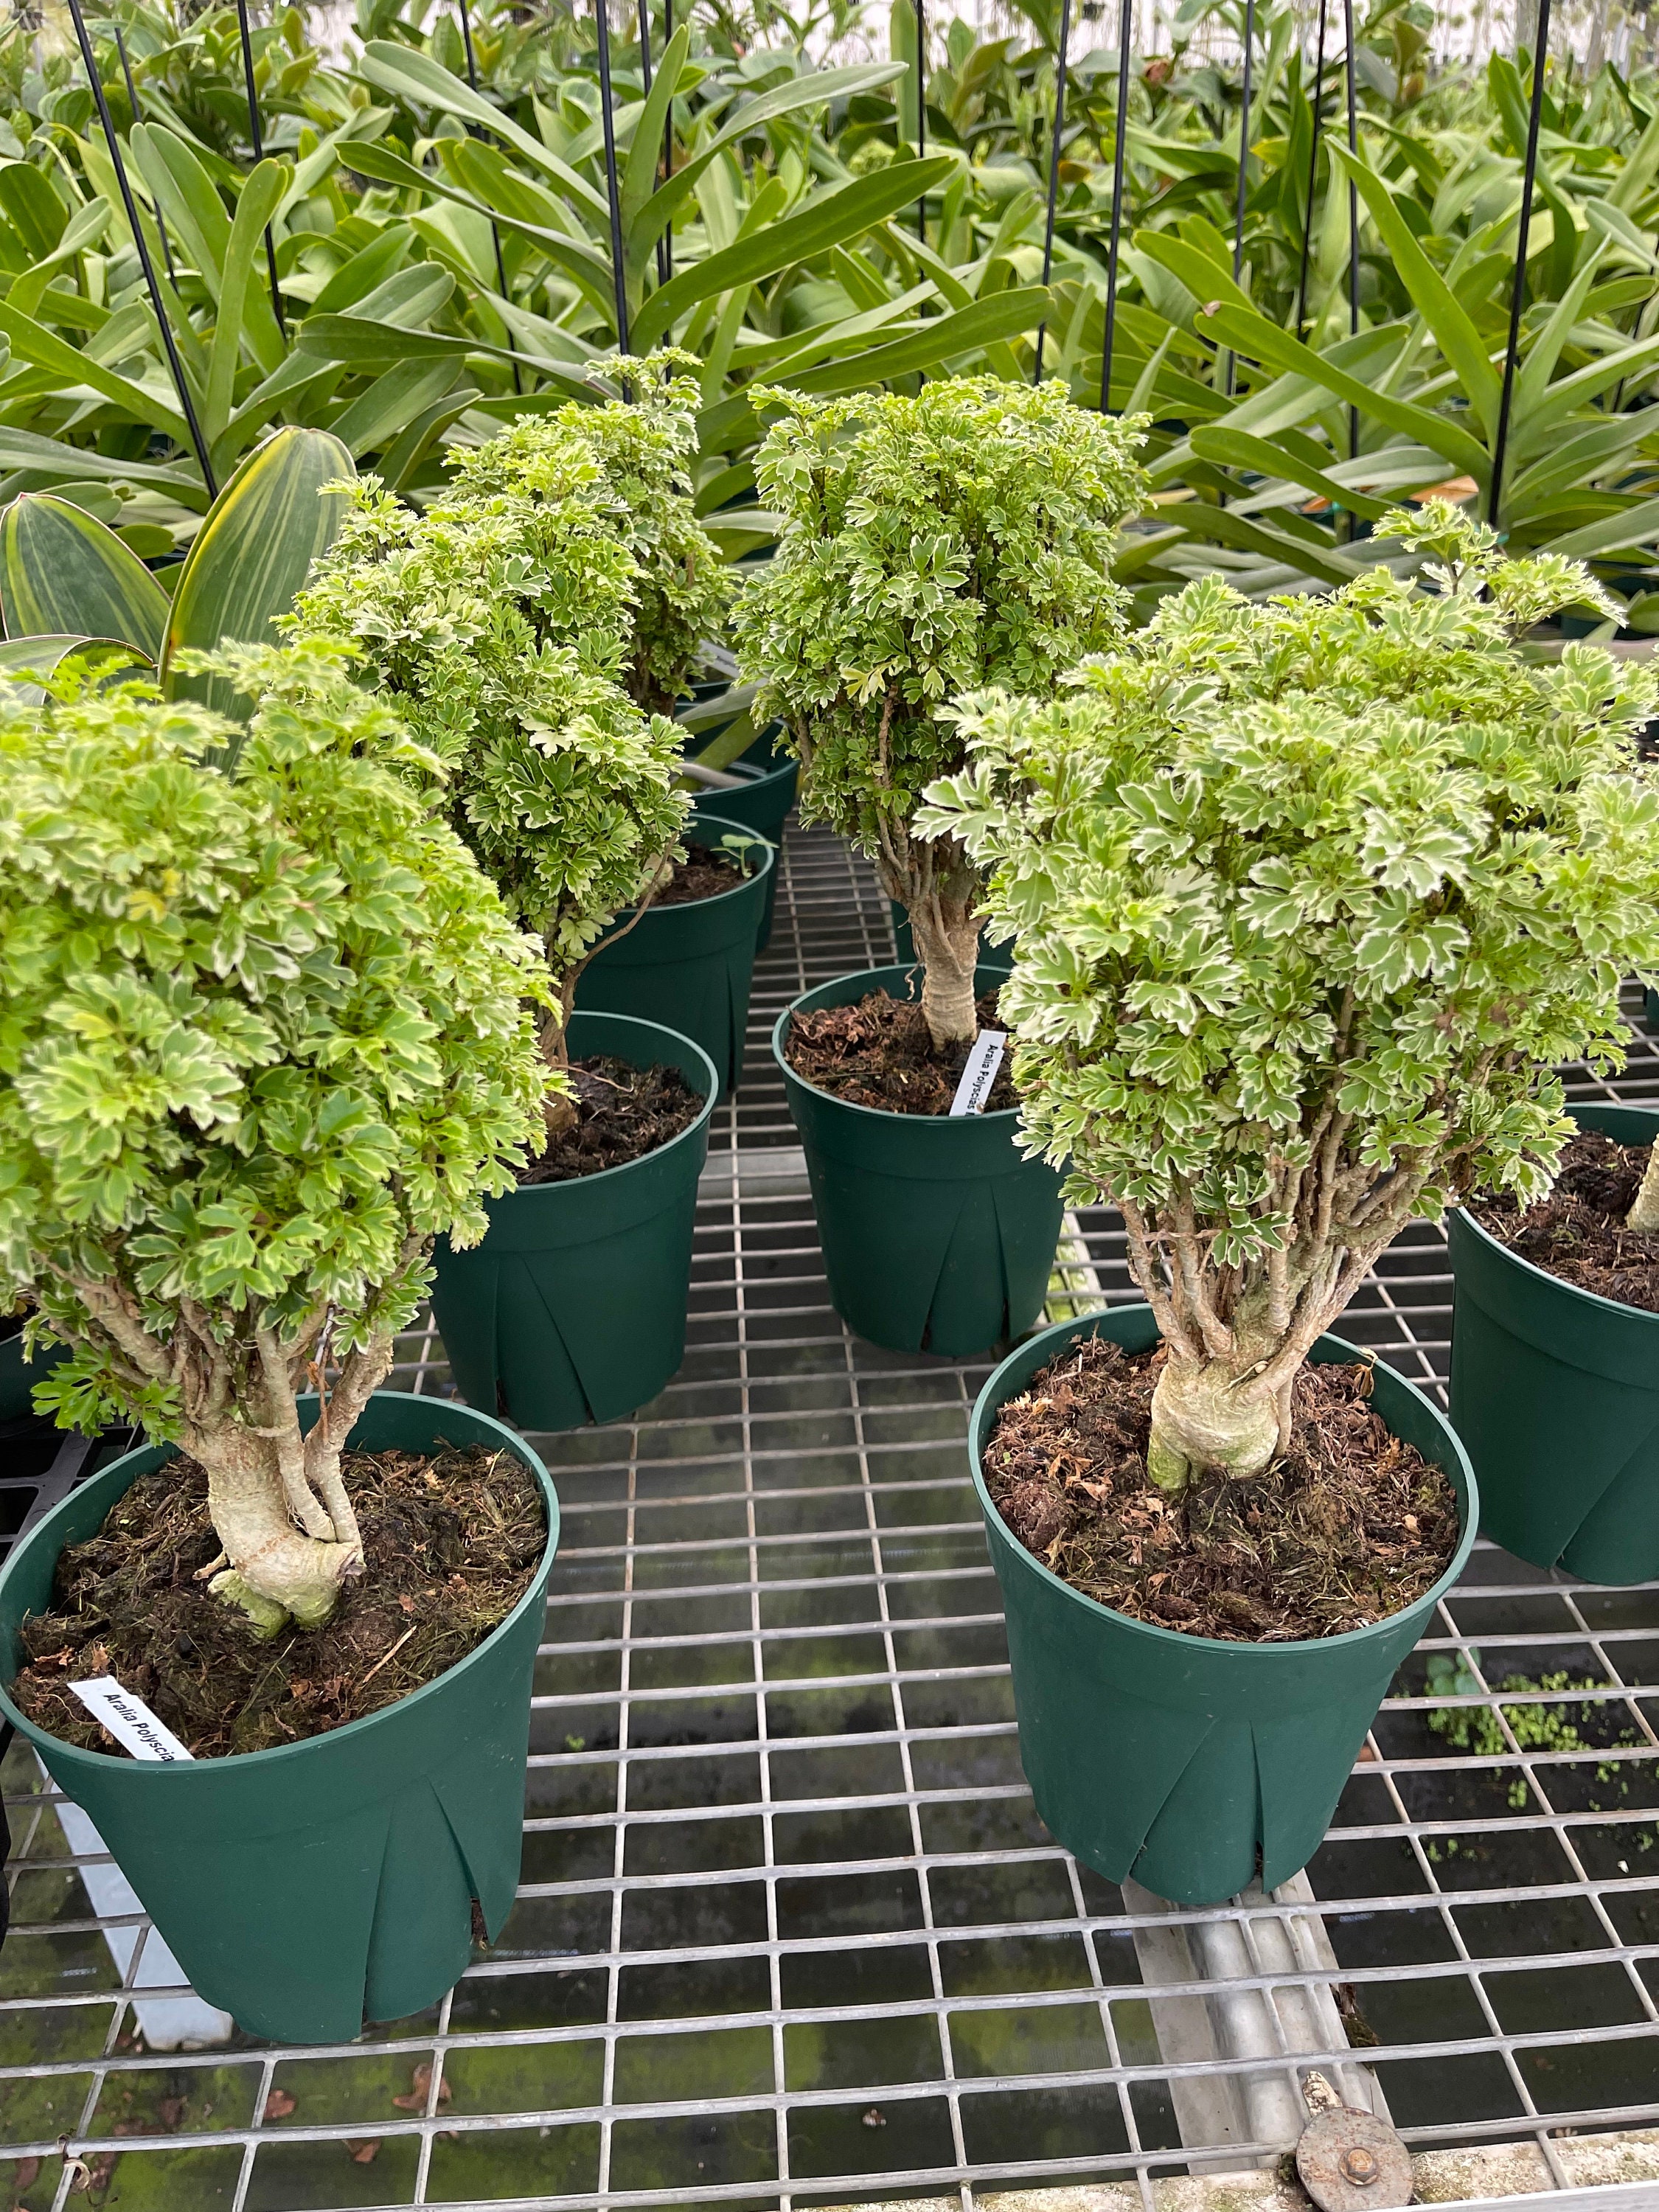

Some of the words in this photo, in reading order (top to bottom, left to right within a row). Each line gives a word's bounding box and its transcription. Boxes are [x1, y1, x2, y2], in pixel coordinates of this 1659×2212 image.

[982, 1044, 998, 1068] Aralia
[967, 1071, 990, 1109] Polyscias
[102, 1694, 137, 1721] Aralia
